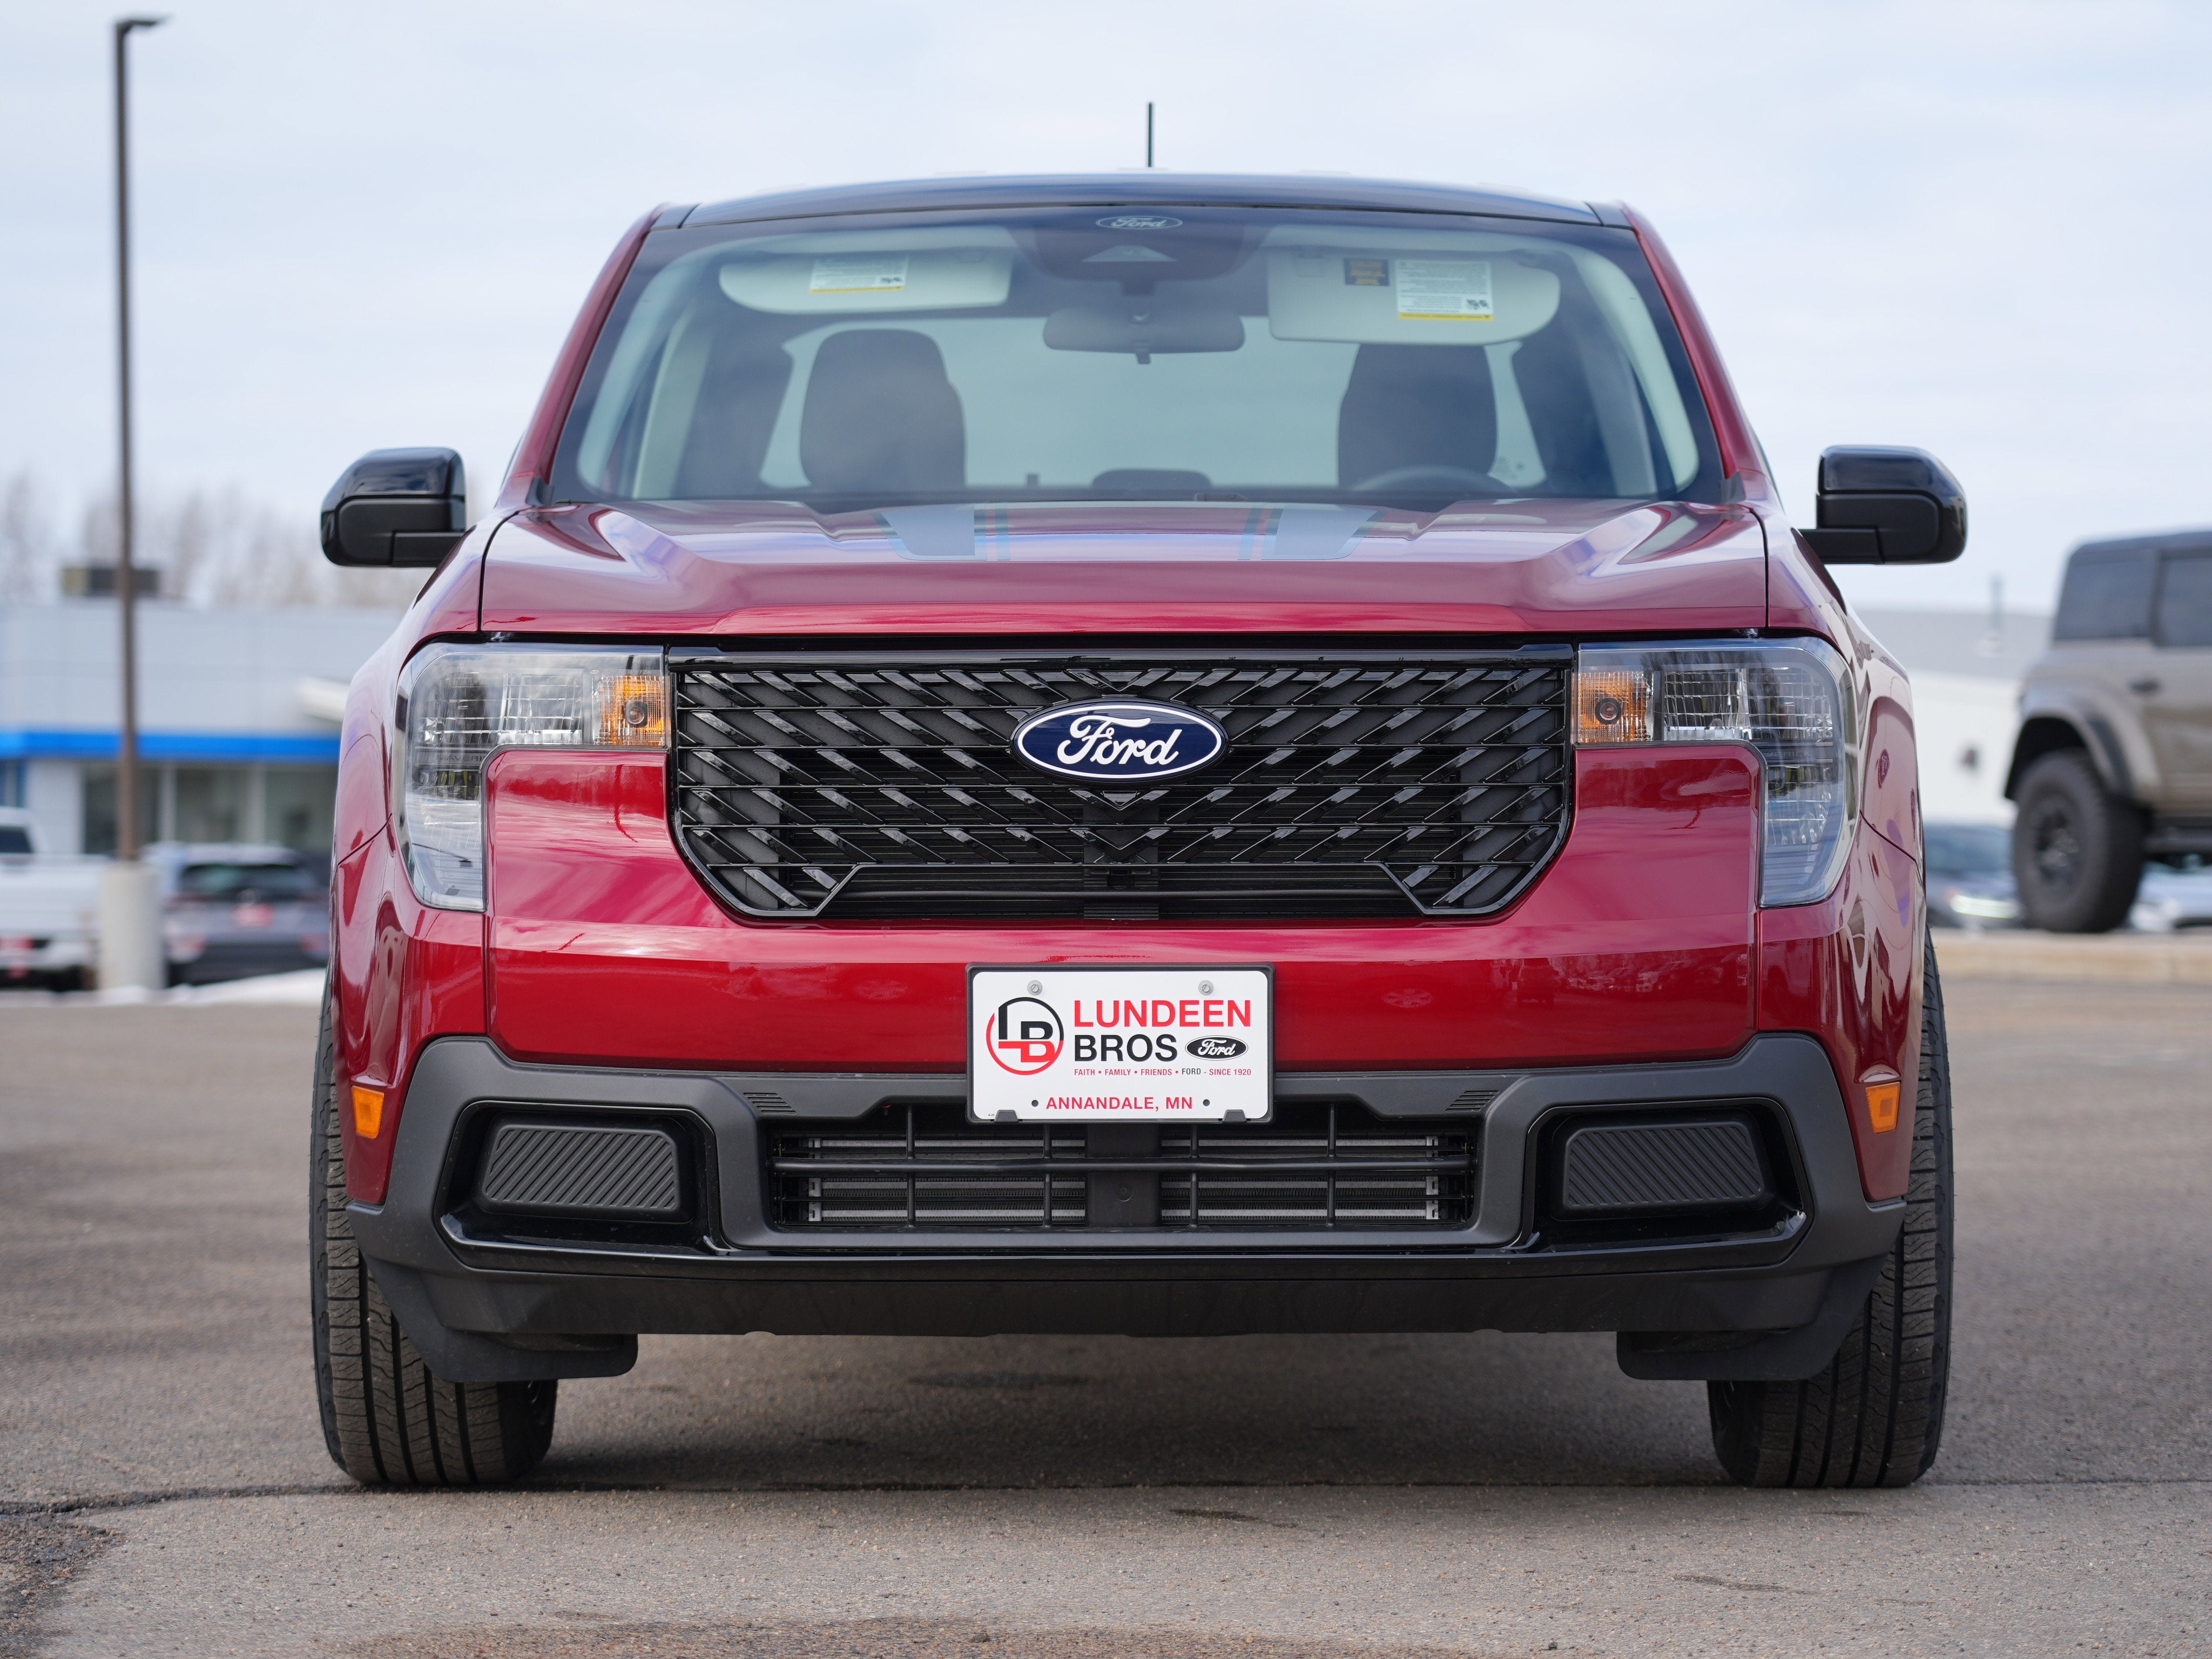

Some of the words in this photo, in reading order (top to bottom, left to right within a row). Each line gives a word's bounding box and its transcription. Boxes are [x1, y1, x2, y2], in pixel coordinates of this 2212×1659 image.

[1111, 218, 1168, 227] Ford
[1057, 715, 1183, 765] Ford
[1074, 1000, 1251, 1027] LUNDEEN
[1074, 1034, 1177, 1062] BROS
[1197, 1039, 1237, 1056] Ford
[1046, 1097, 1159, 1112] ANNANDALE,
[1166, 1097, 1192, 1109] MN
